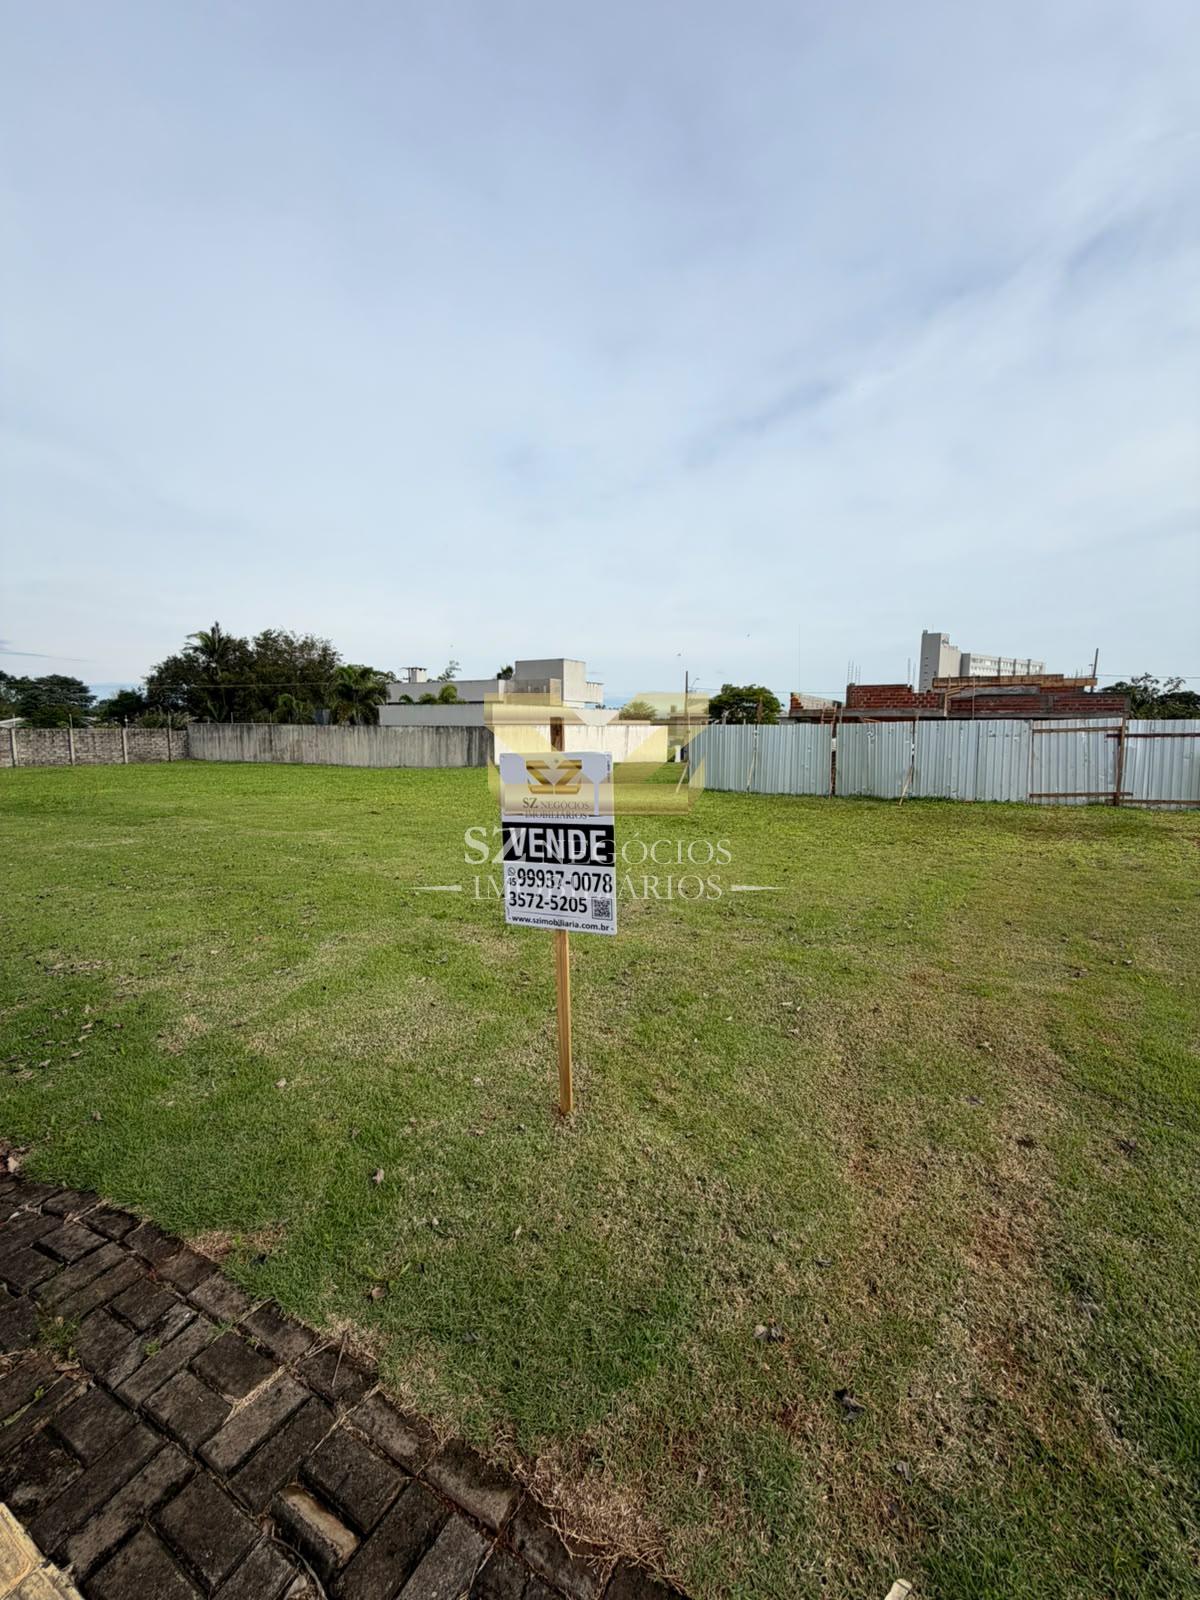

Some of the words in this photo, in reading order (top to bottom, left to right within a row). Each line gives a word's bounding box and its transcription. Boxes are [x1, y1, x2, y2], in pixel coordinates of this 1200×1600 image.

[522, 797, 539, 809] SZ
[508, 827, 608, 861] VENDE
[517, 867, 613, 893] 99937-0078
[508, 891, 588, 913] 3572-5205
[511, 914, 610, 932] www.szimobiliaria.com.br
